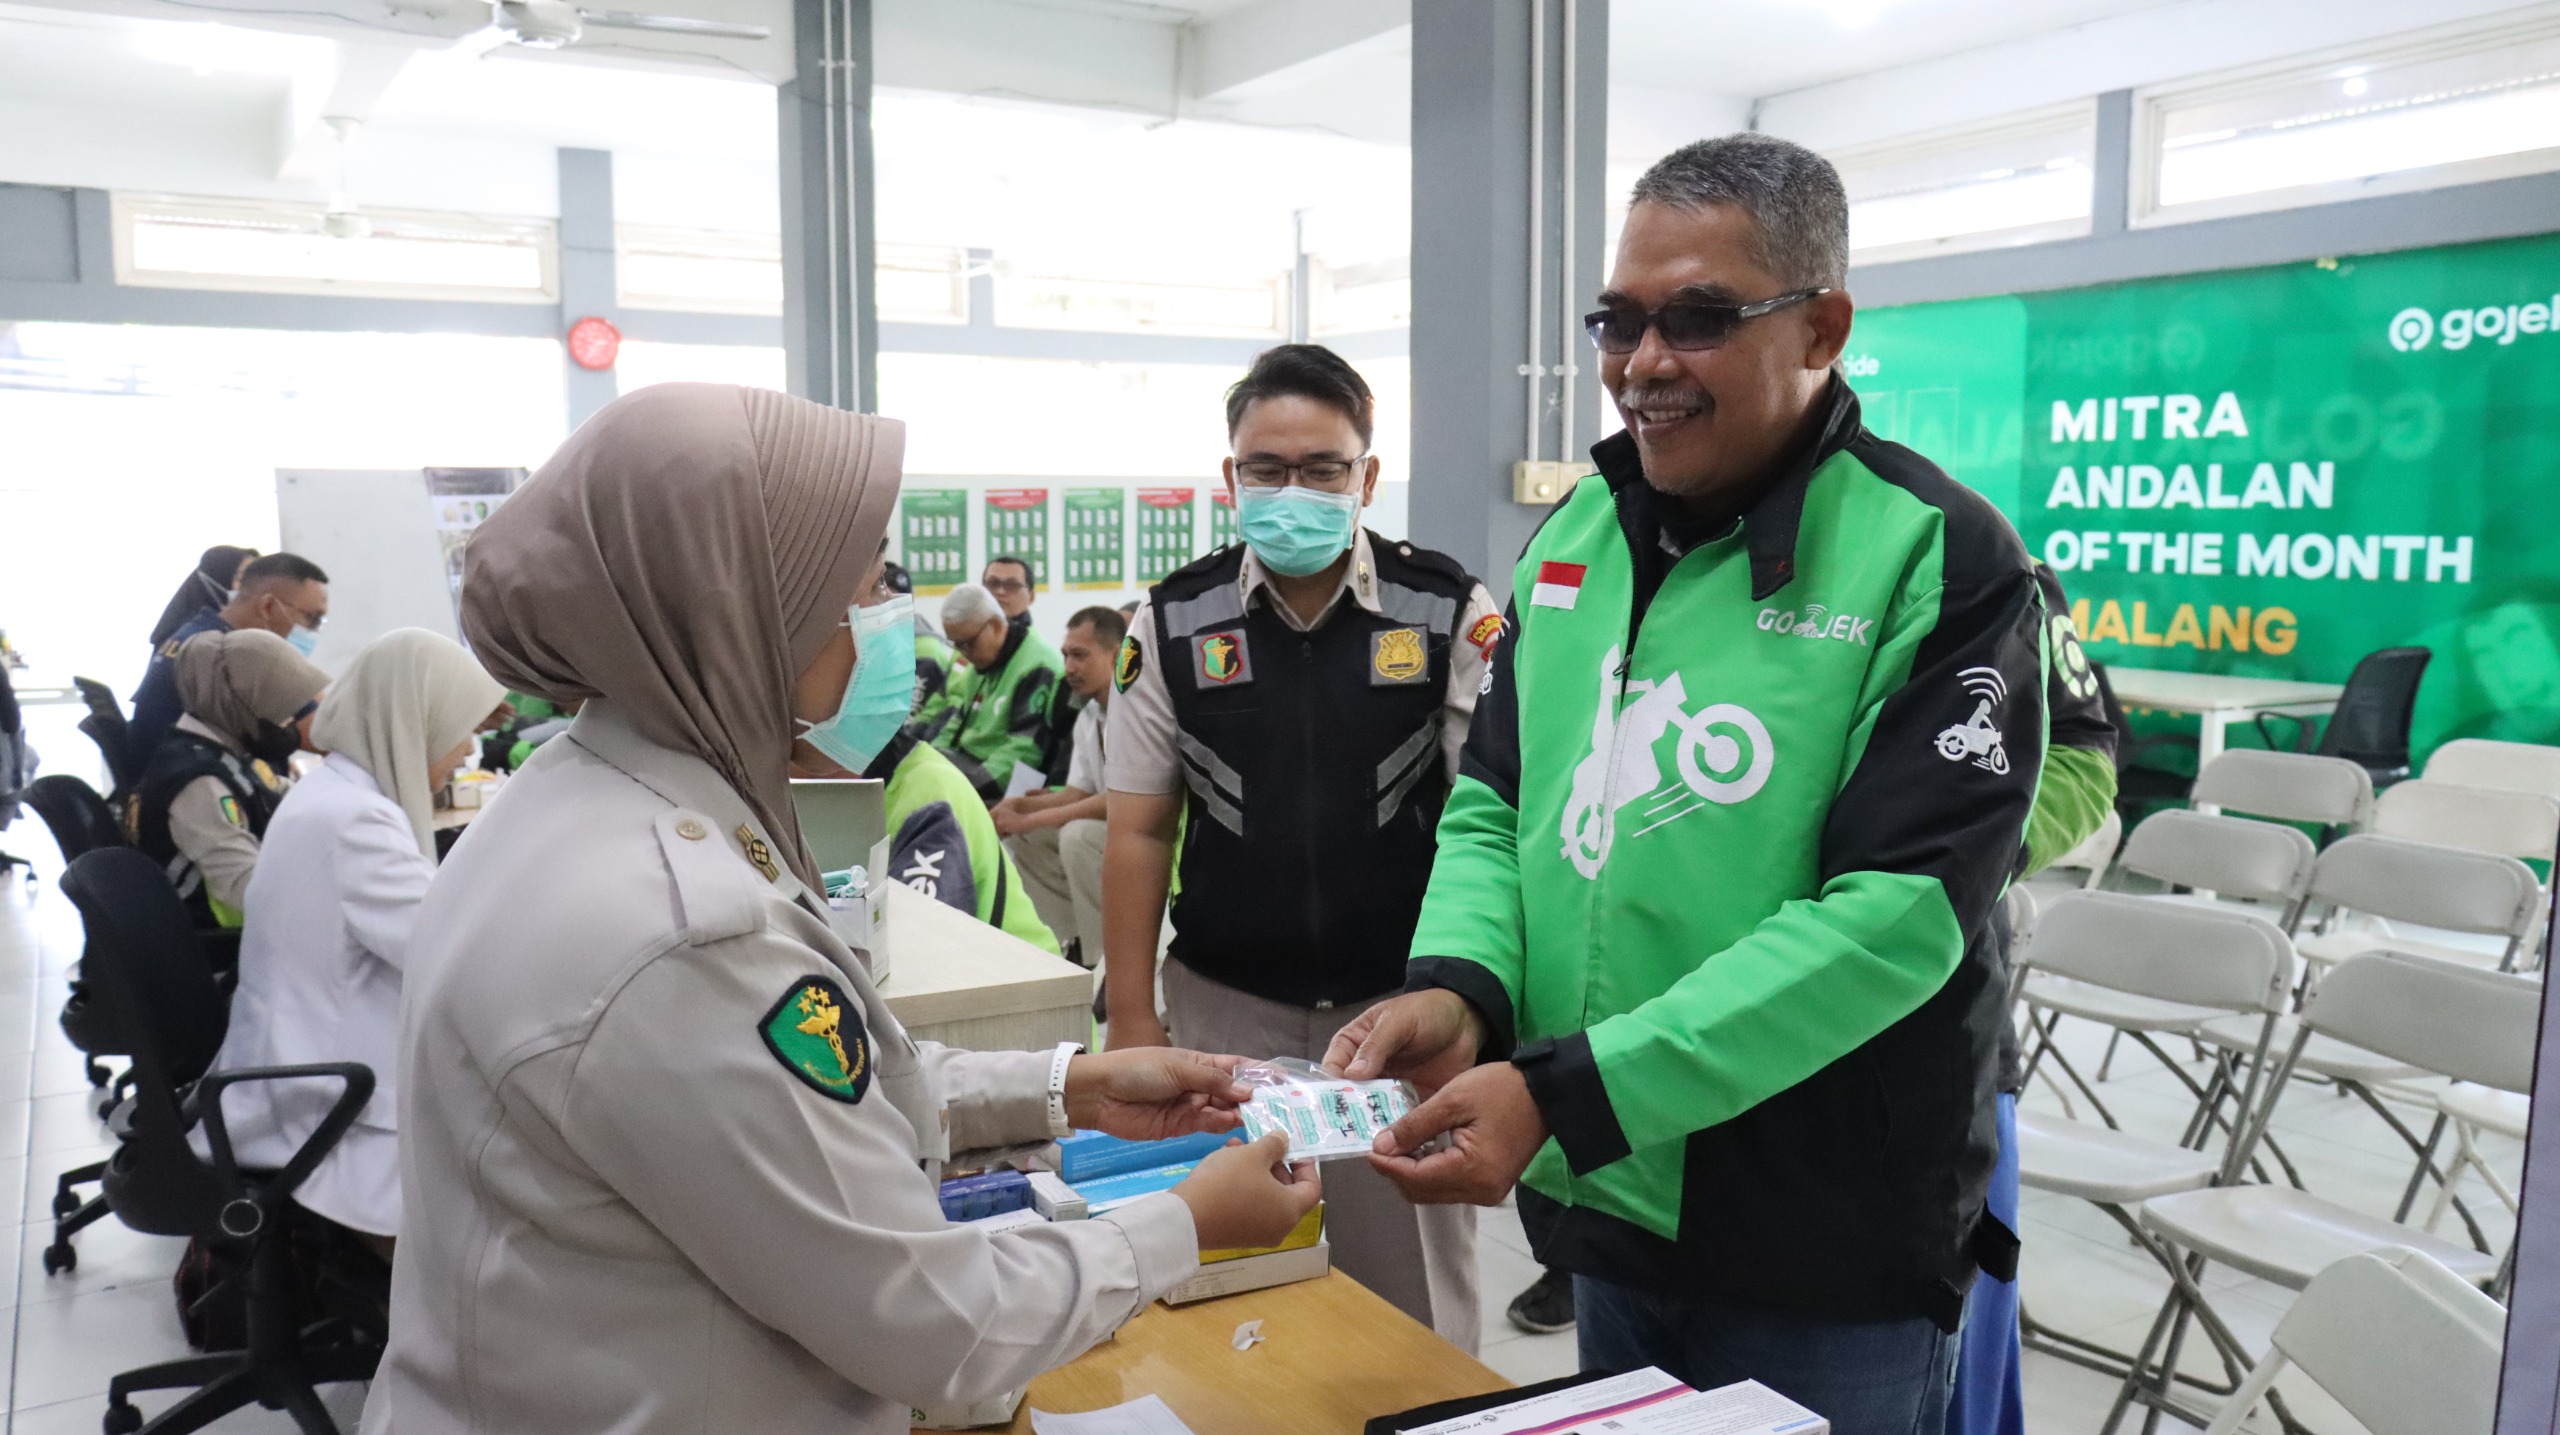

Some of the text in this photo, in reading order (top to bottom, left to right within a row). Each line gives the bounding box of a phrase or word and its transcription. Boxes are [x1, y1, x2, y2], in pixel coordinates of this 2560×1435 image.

[2051, 391, 2249, 443] MITRA
[2046, 461, 2335, 509] ANDALAN
[2044, 529, 2474, 583] OF THE MONTH
[2067, 598, 2298, 655] MALANG
